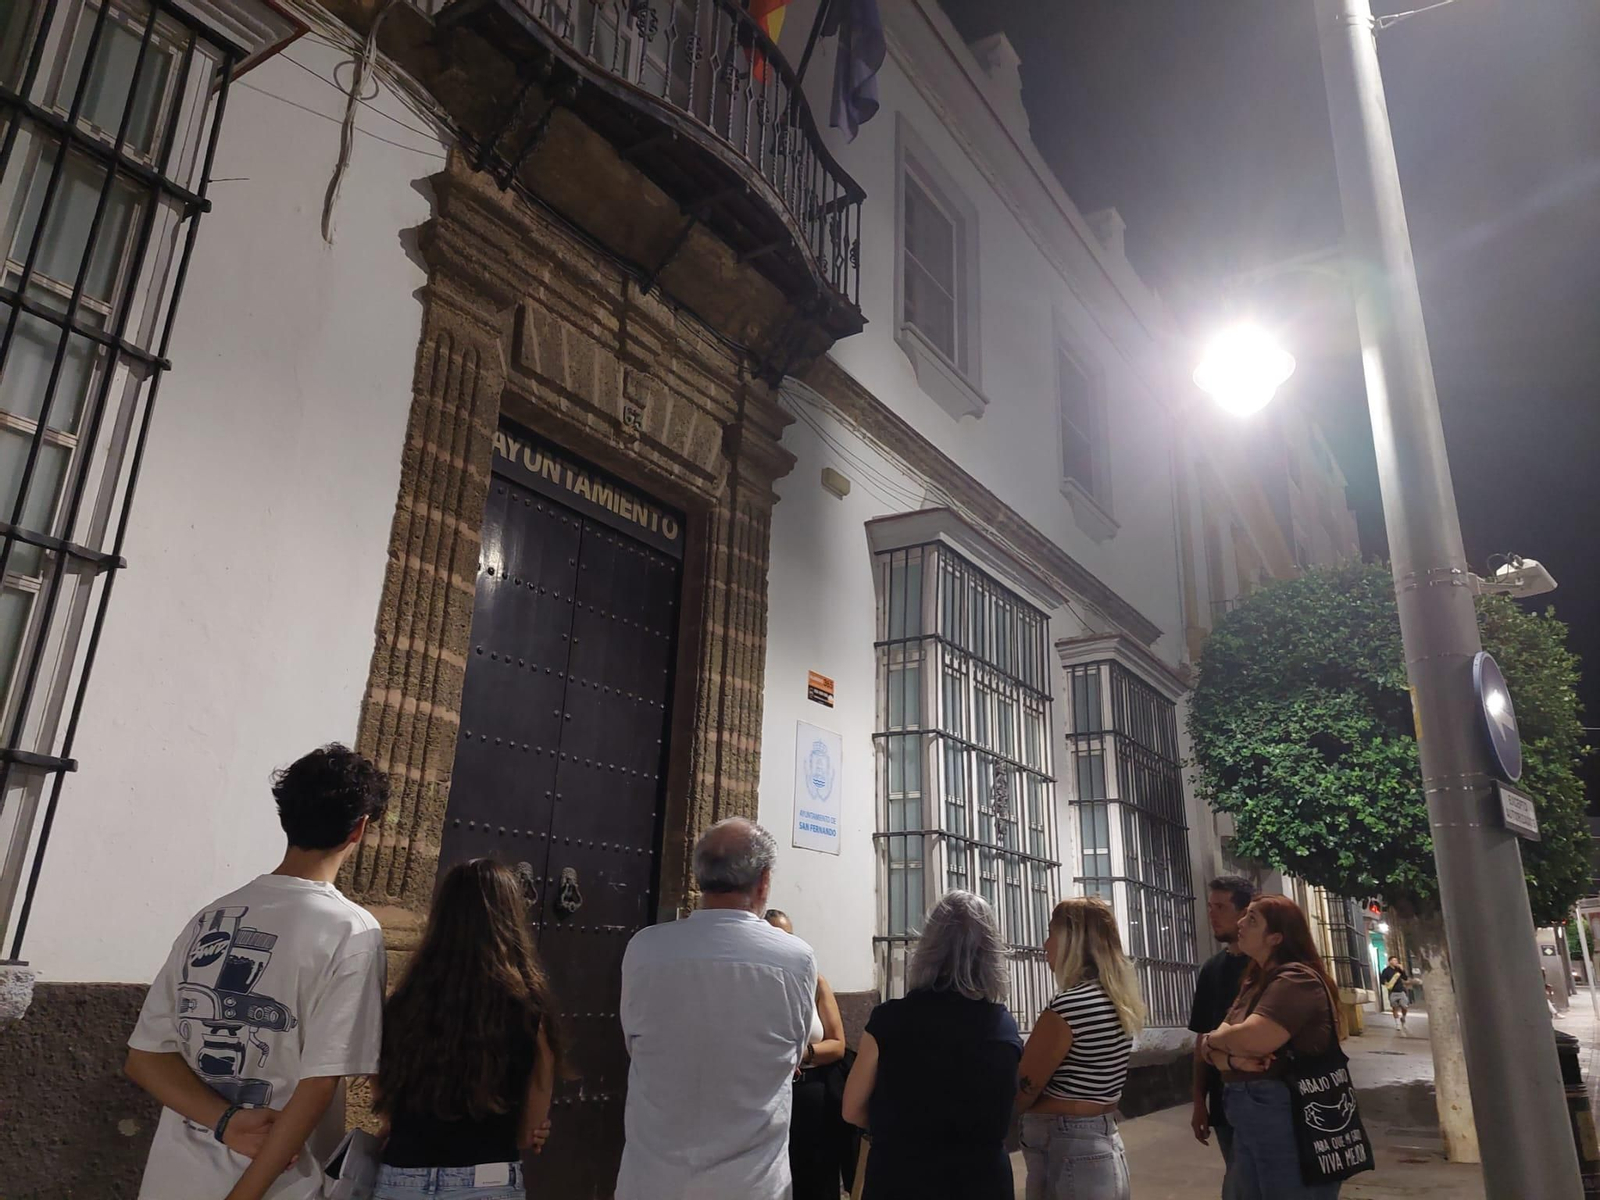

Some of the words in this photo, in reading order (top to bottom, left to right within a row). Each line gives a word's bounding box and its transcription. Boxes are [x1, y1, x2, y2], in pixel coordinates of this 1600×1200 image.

[492, 431, 679, 540] AYUNTAMIENTO
[799, 821, 810, 831] SAN
[810, 824, 837, 837] FERNANDO
[1298, 1076, 1330, 1095] RABAJO
[1313, 1139, 1330, 1154] PARA
[1318, 1151, 1344, 1174] VIVA
